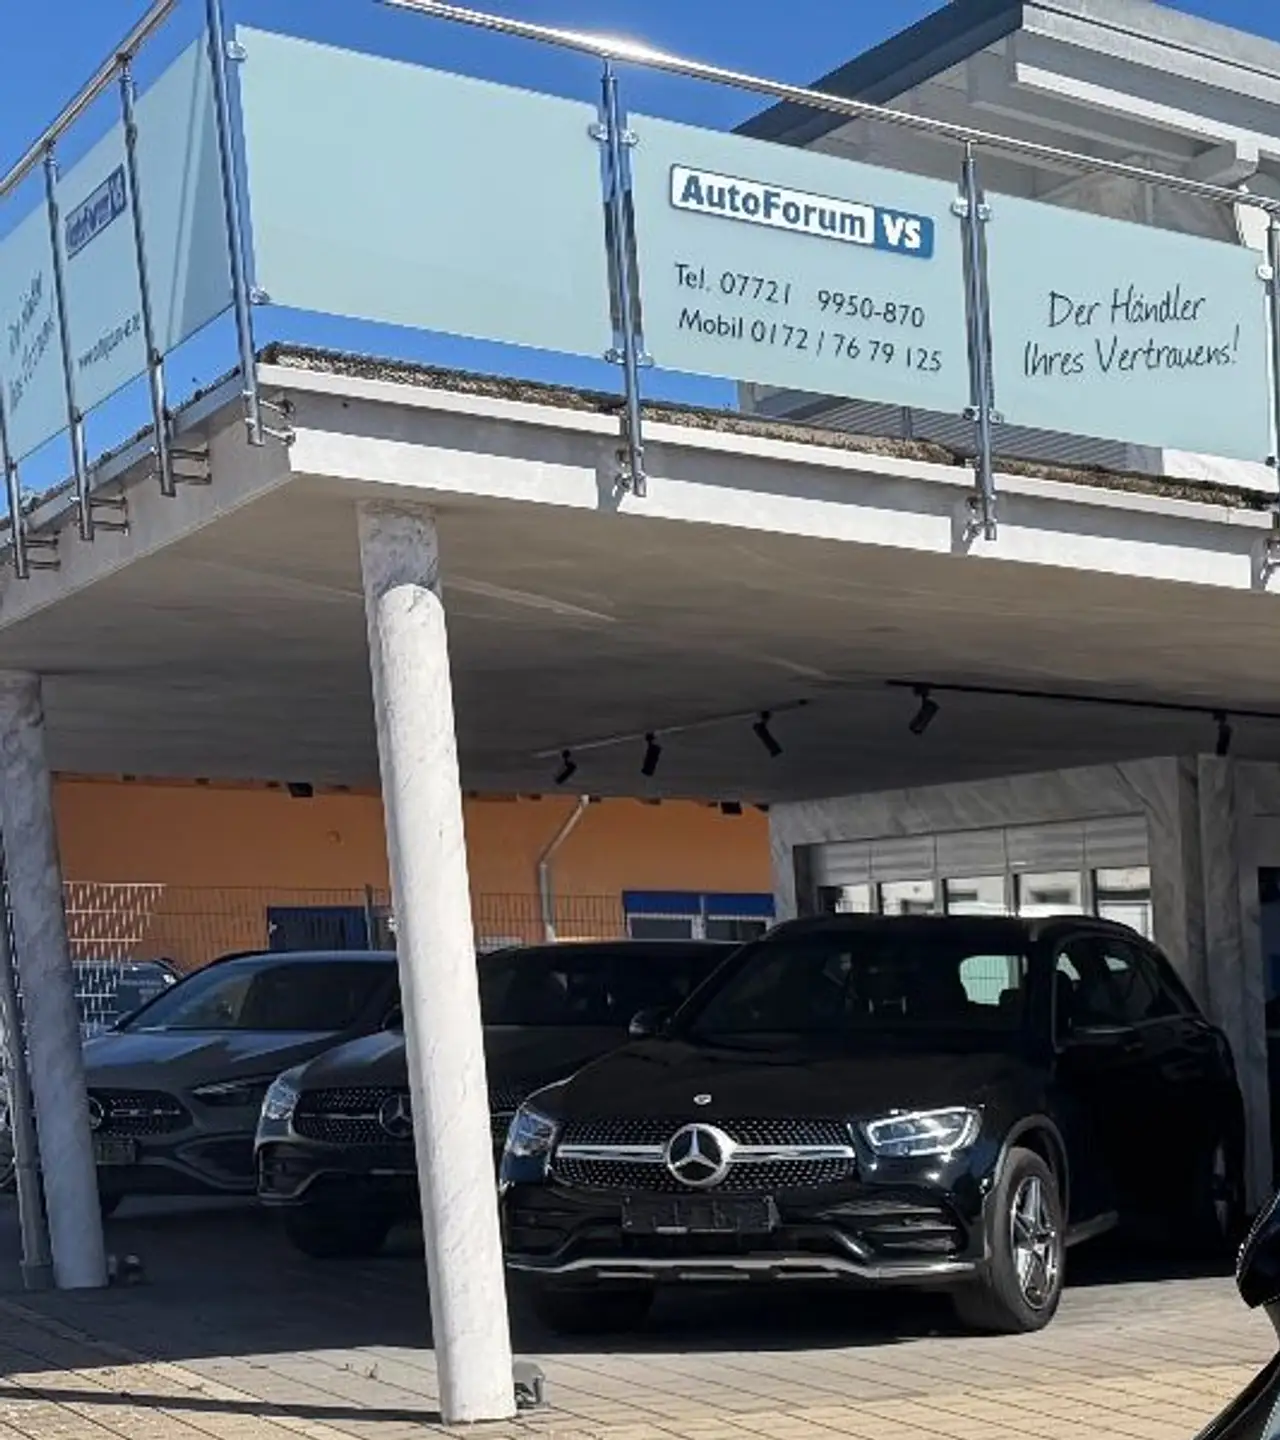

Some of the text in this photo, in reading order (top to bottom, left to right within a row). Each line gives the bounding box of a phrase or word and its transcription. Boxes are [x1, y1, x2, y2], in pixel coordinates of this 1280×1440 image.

[680, 174, 922, 249] AutoForum VS
[674, 262, 926, 328] Tel. 07721 9950-870
[1047, 282, 1206, 327] Der Händler
[678, 307, 744, 339] Mobil
[750, 320, 809, 350] 0172
[832, 332, 861, 359] 76
[867, 339, 895, 364] 79
[907, 347, 942, 372] 125
[1024, 322, 1241, 376] Ihres Vertrauens!
